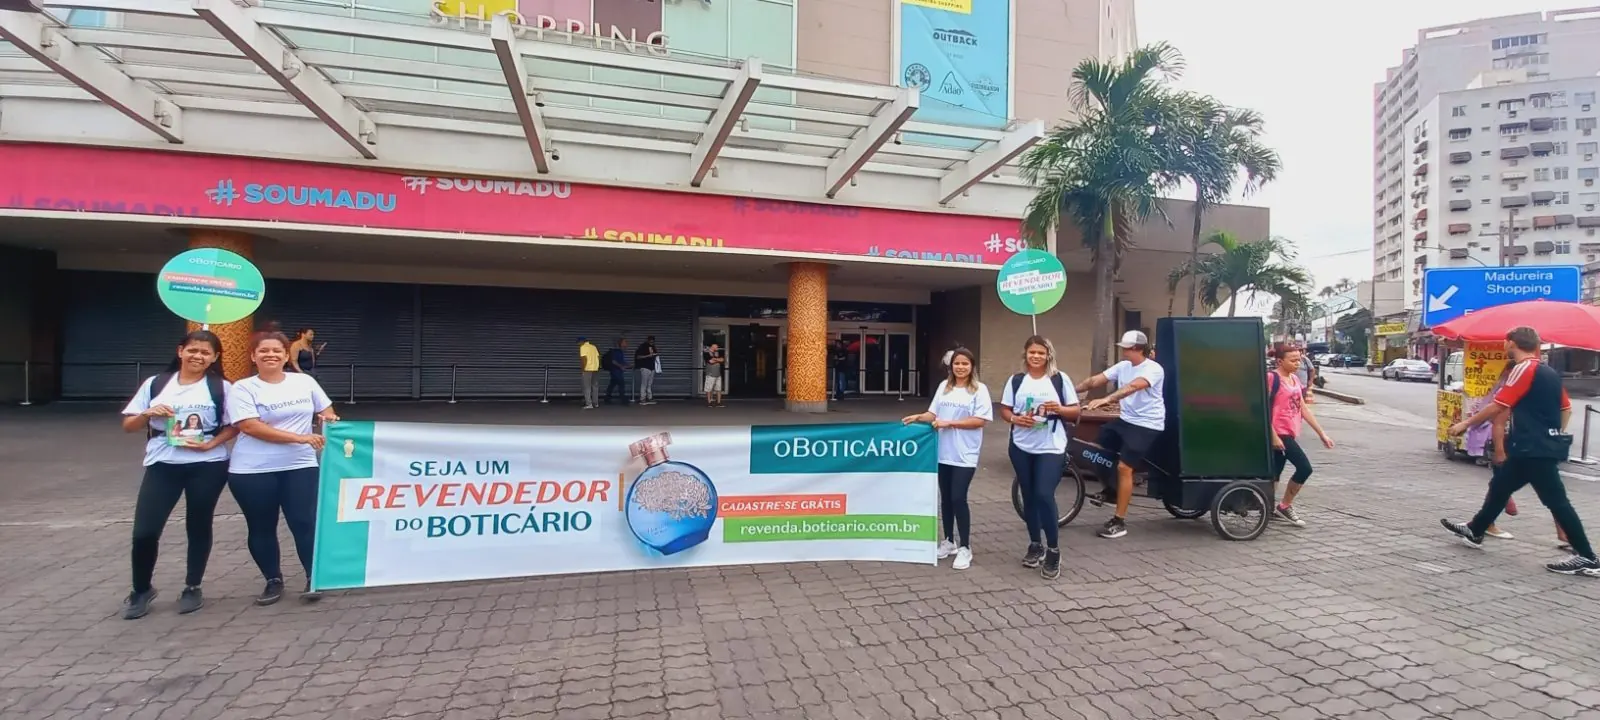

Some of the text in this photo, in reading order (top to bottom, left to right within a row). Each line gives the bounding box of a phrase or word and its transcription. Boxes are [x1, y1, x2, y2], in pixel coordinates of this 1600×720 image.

[430, 0, 670, 56] SHOPPING
[932, 31, 978, 46] OUTBACK
[1484, 271, 1553, 281] Madureira
[1486, 284, 1552, 295] Shopping
[1082, 449, 1113, 468] exfera
[409, 460, 509, 476] SEJA UM
[355, 480, 611, 510] REVENDEDOR
[721, 499, 841, 511] CADASTRE-SE GRÁTIS
[395, 506, 592, 538] DO BOTICÁRIO
[740, 520, 921, 535] revenda.boticario.com.br
